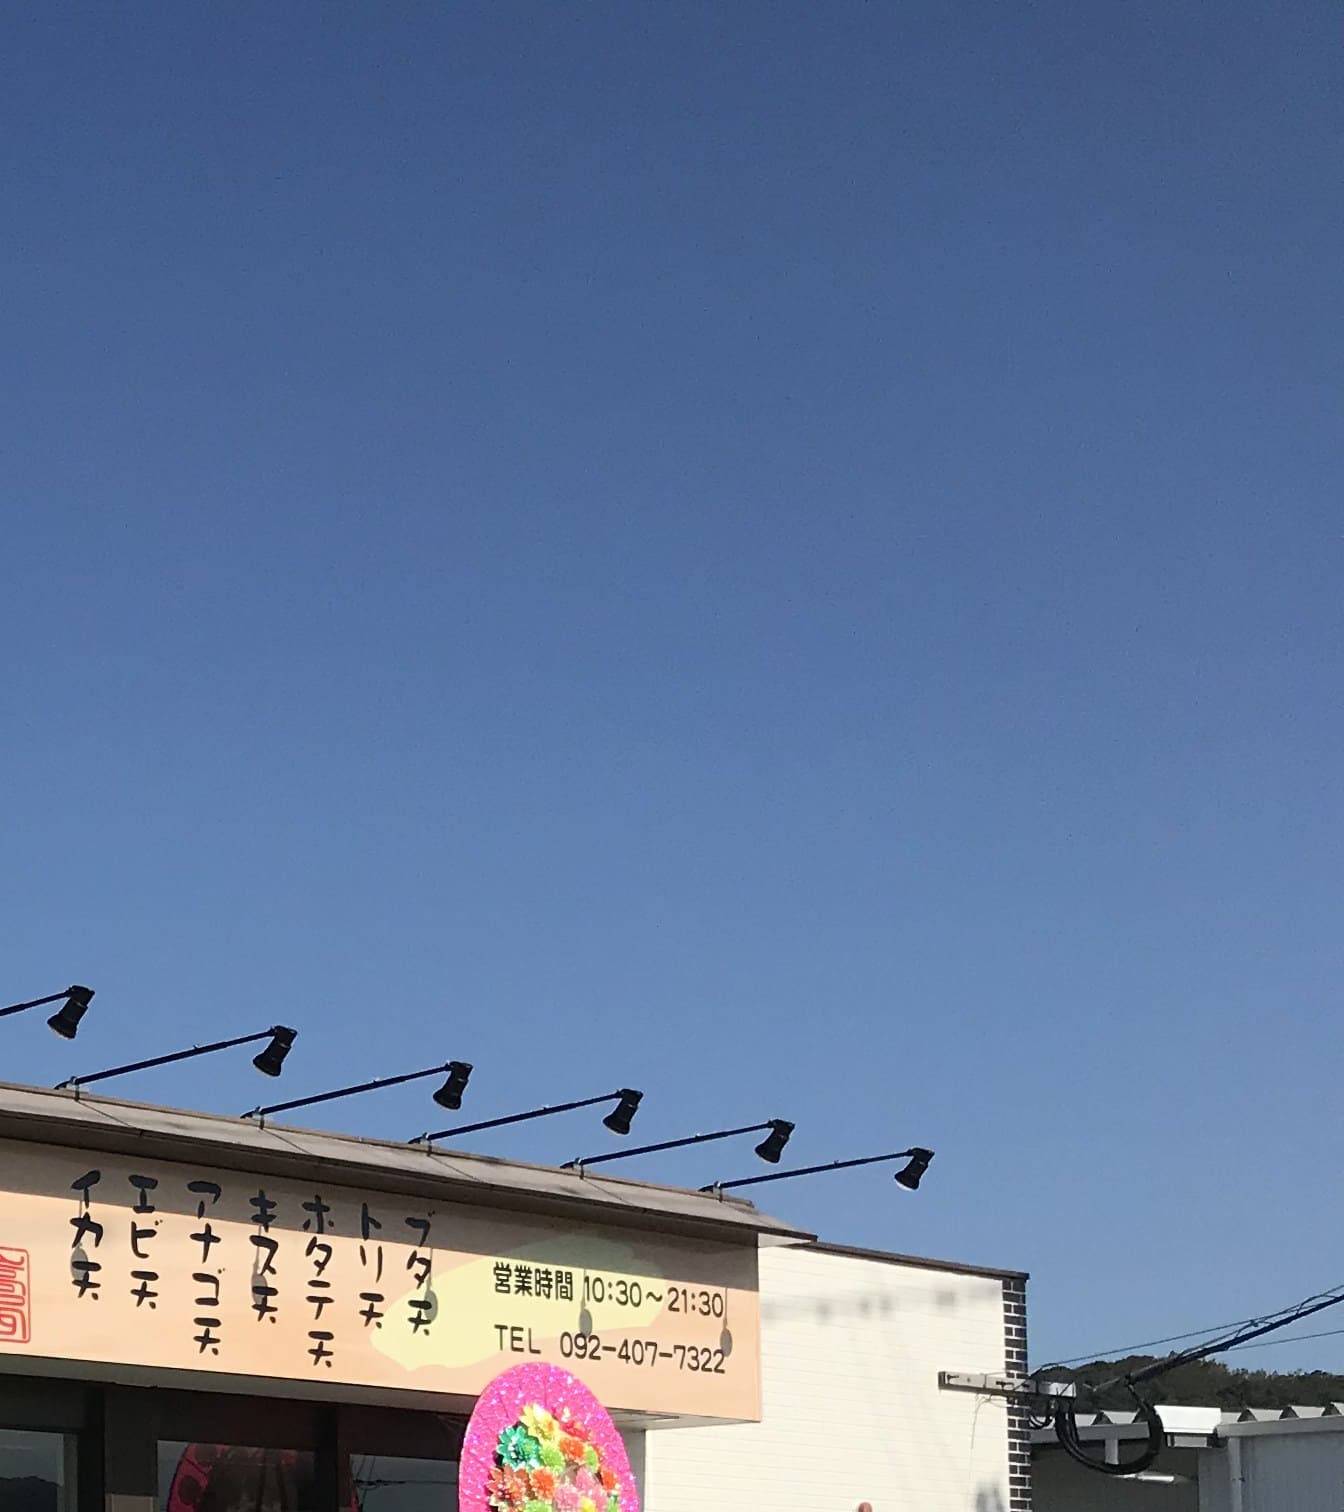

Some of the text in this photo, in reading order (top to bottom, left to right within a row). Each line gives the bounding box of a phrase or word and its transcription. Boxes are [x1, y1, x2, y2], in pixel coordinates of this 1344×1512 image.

[70, 1169, 103, 1300] イカ天
[128, 1174, 163, 1309] エビ天
[187, 1180, 226, 1356] アナゴ天
[249, 1189, 278, 1324] キス天
[302, 1194, 334, 1368] ホタテ天
[359, 1202, 385, 1329] トリ天
[405, 1210, 435, 1336] ブタ天
[493, 1261, 573, 1302] 営業時間
[494, 1324, 726, 1374] TEL 092-407-7322
